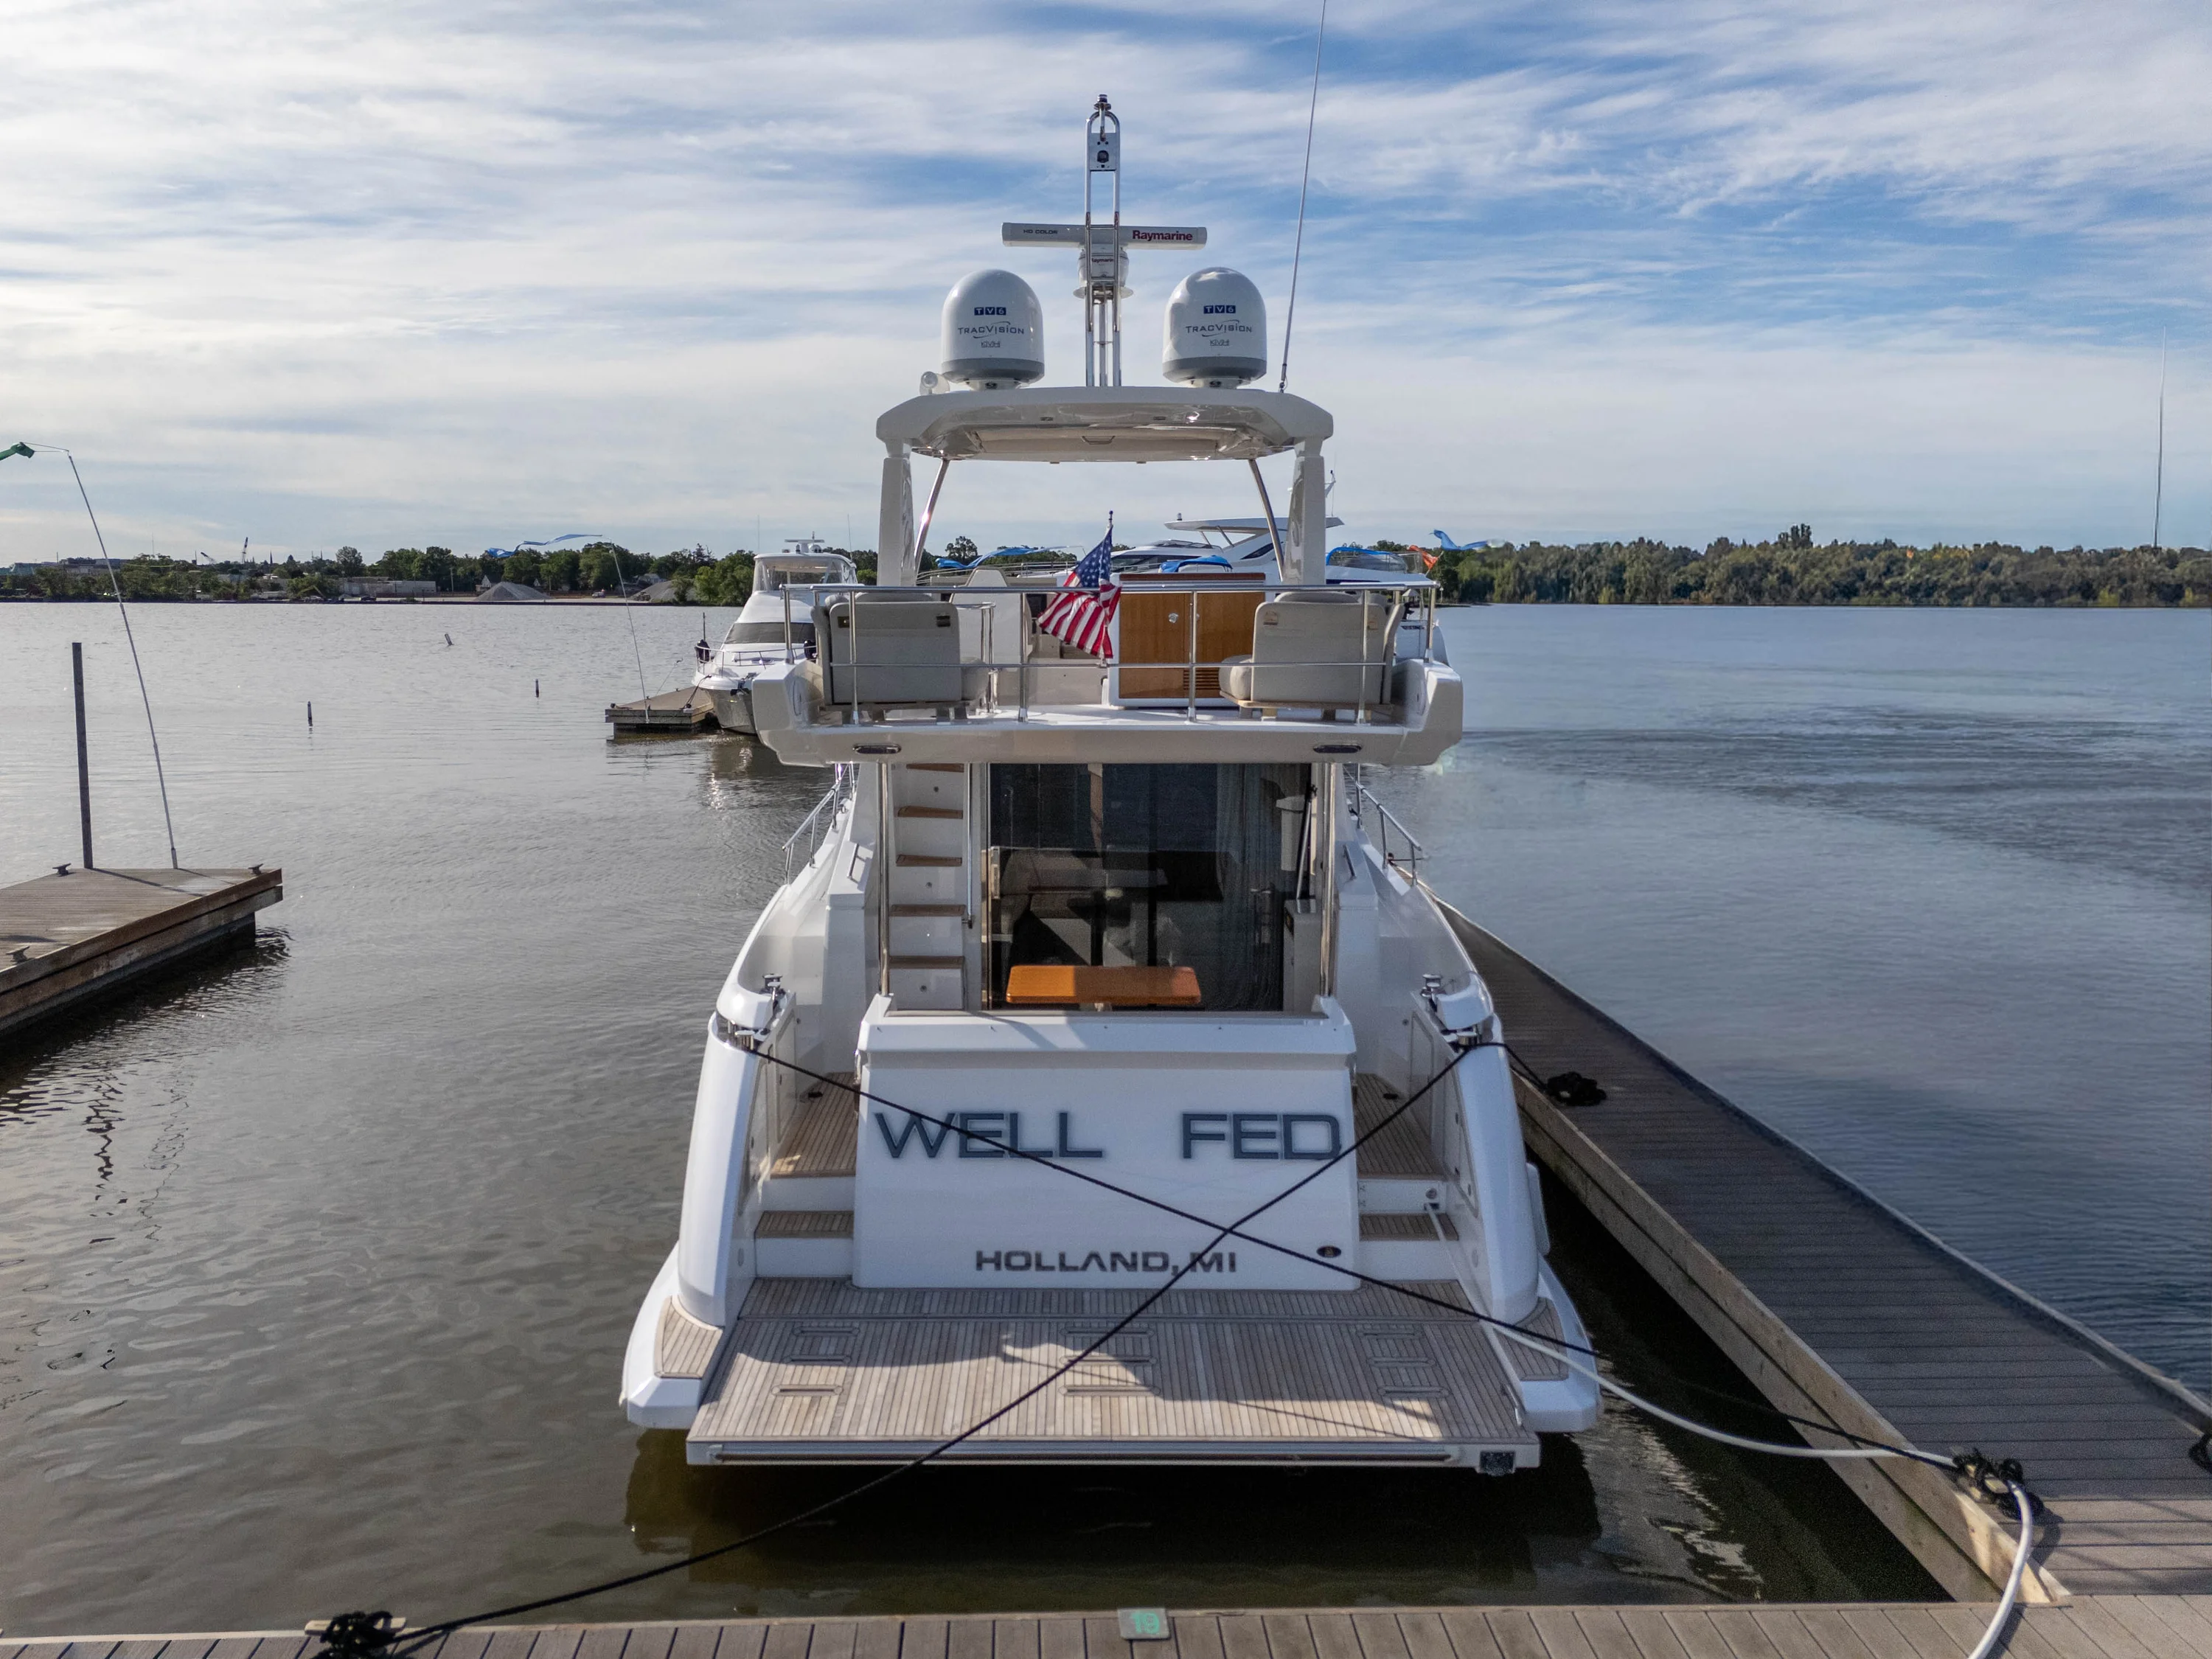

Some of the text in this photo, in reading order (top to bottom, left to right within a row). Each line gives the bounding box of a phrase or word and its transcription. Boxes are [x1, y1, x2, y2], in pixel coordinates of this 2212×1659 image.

[1132, 230, 1193, 242] Raymarine
[974, 307, 1006, 316] TV6
[1203, 305, 1236, 314] TV6
[875, 1112, 1342, 1160] WELL FED
[1189, 1251, 1237, 1273] MI
